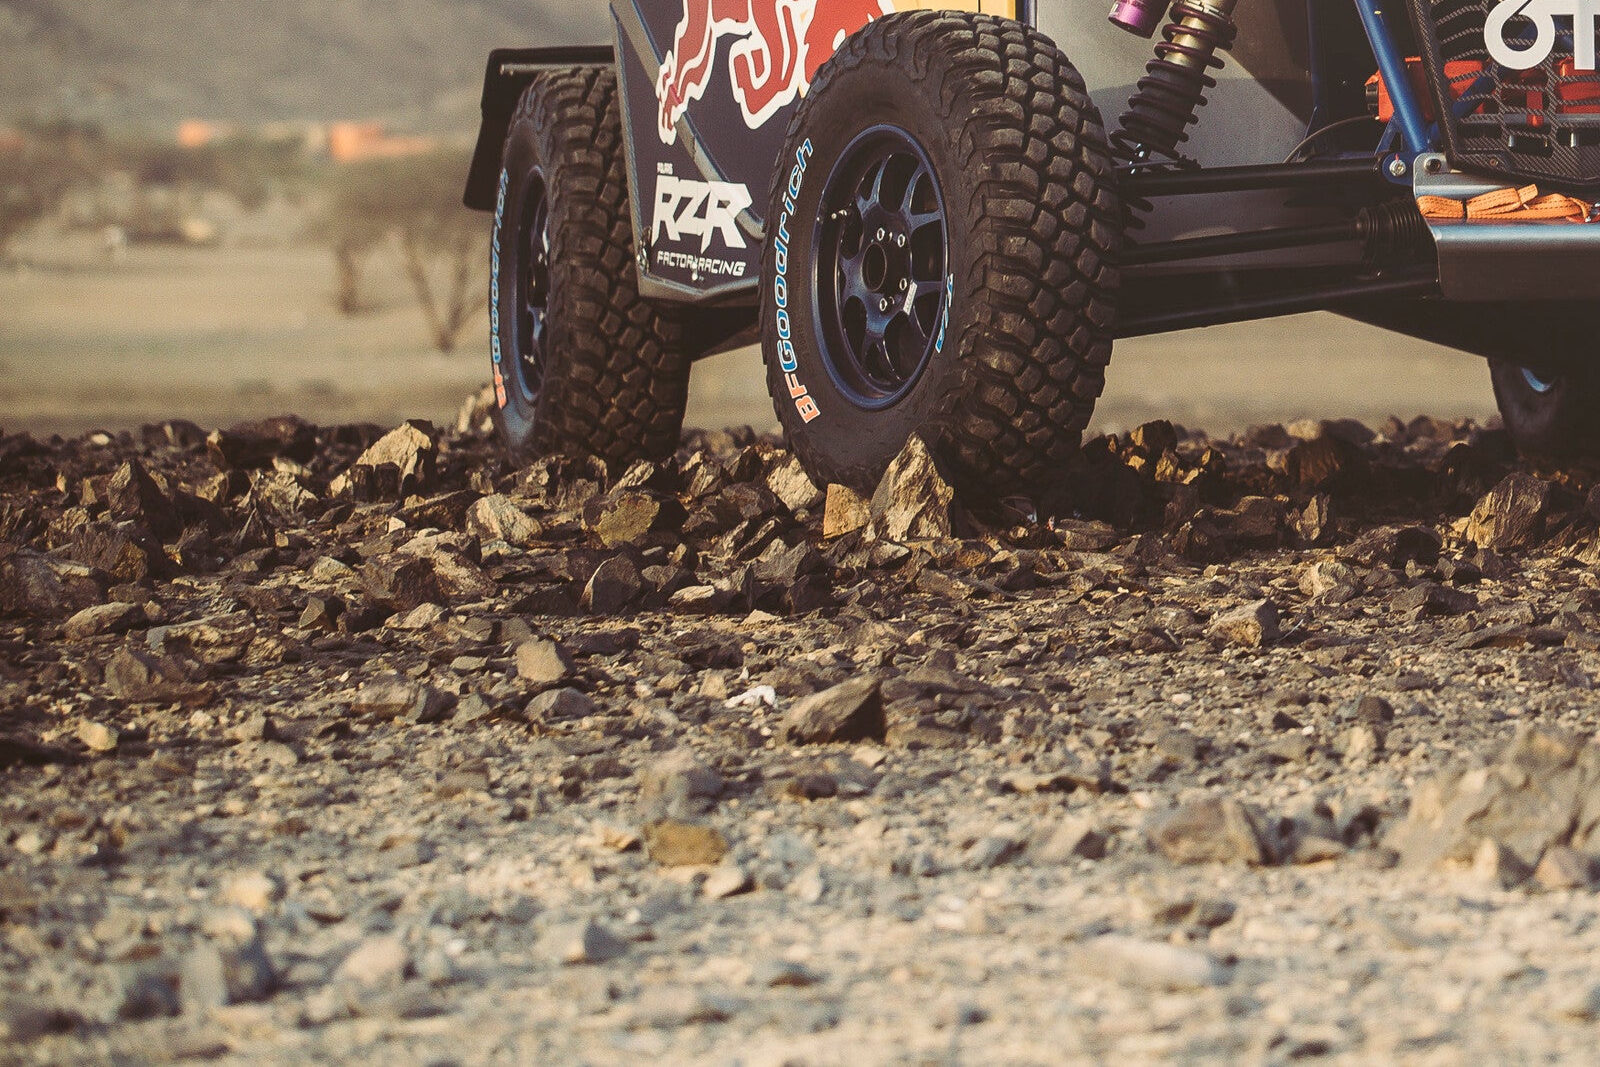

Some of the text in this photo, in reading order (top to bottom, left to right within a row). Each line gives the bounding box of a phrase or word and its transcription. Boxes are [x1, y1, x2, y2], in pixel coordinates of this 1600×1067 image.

[651, 175, 754, 254] RZR
[698, 257, 747, 277] RACING
[774, 137, 821, 424] BFGoodrich
